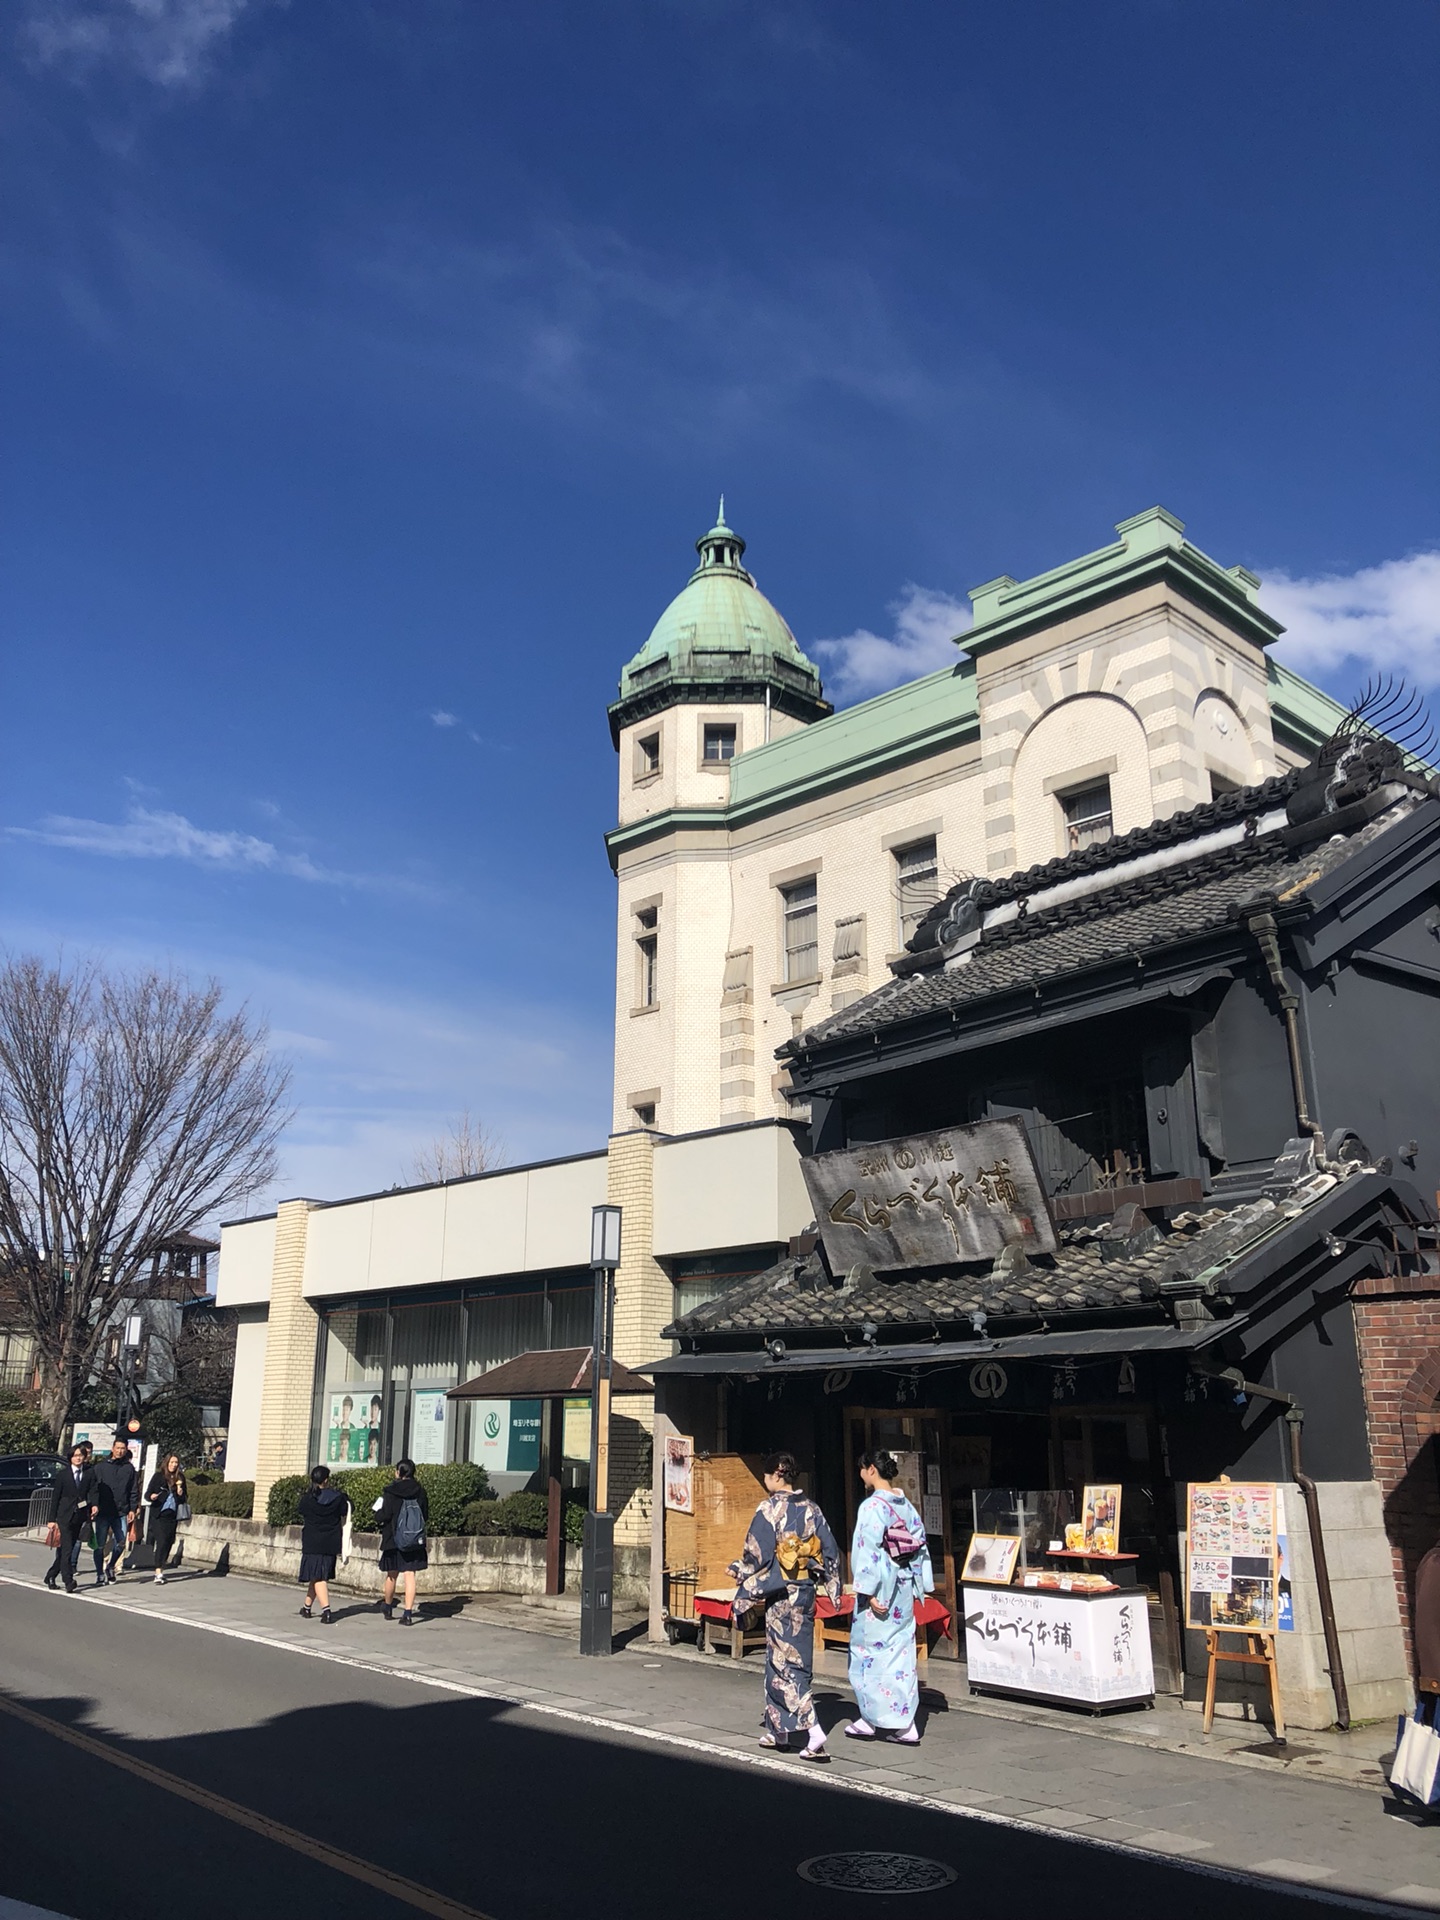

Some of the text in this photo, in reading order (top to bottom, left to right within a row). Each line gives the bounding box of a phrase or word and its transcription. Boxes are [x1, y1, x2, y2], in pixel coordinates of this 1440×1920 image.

[919, 1141, 955, 1165] 川越
[1192, 1561, 1216, 1571] おしるこ
